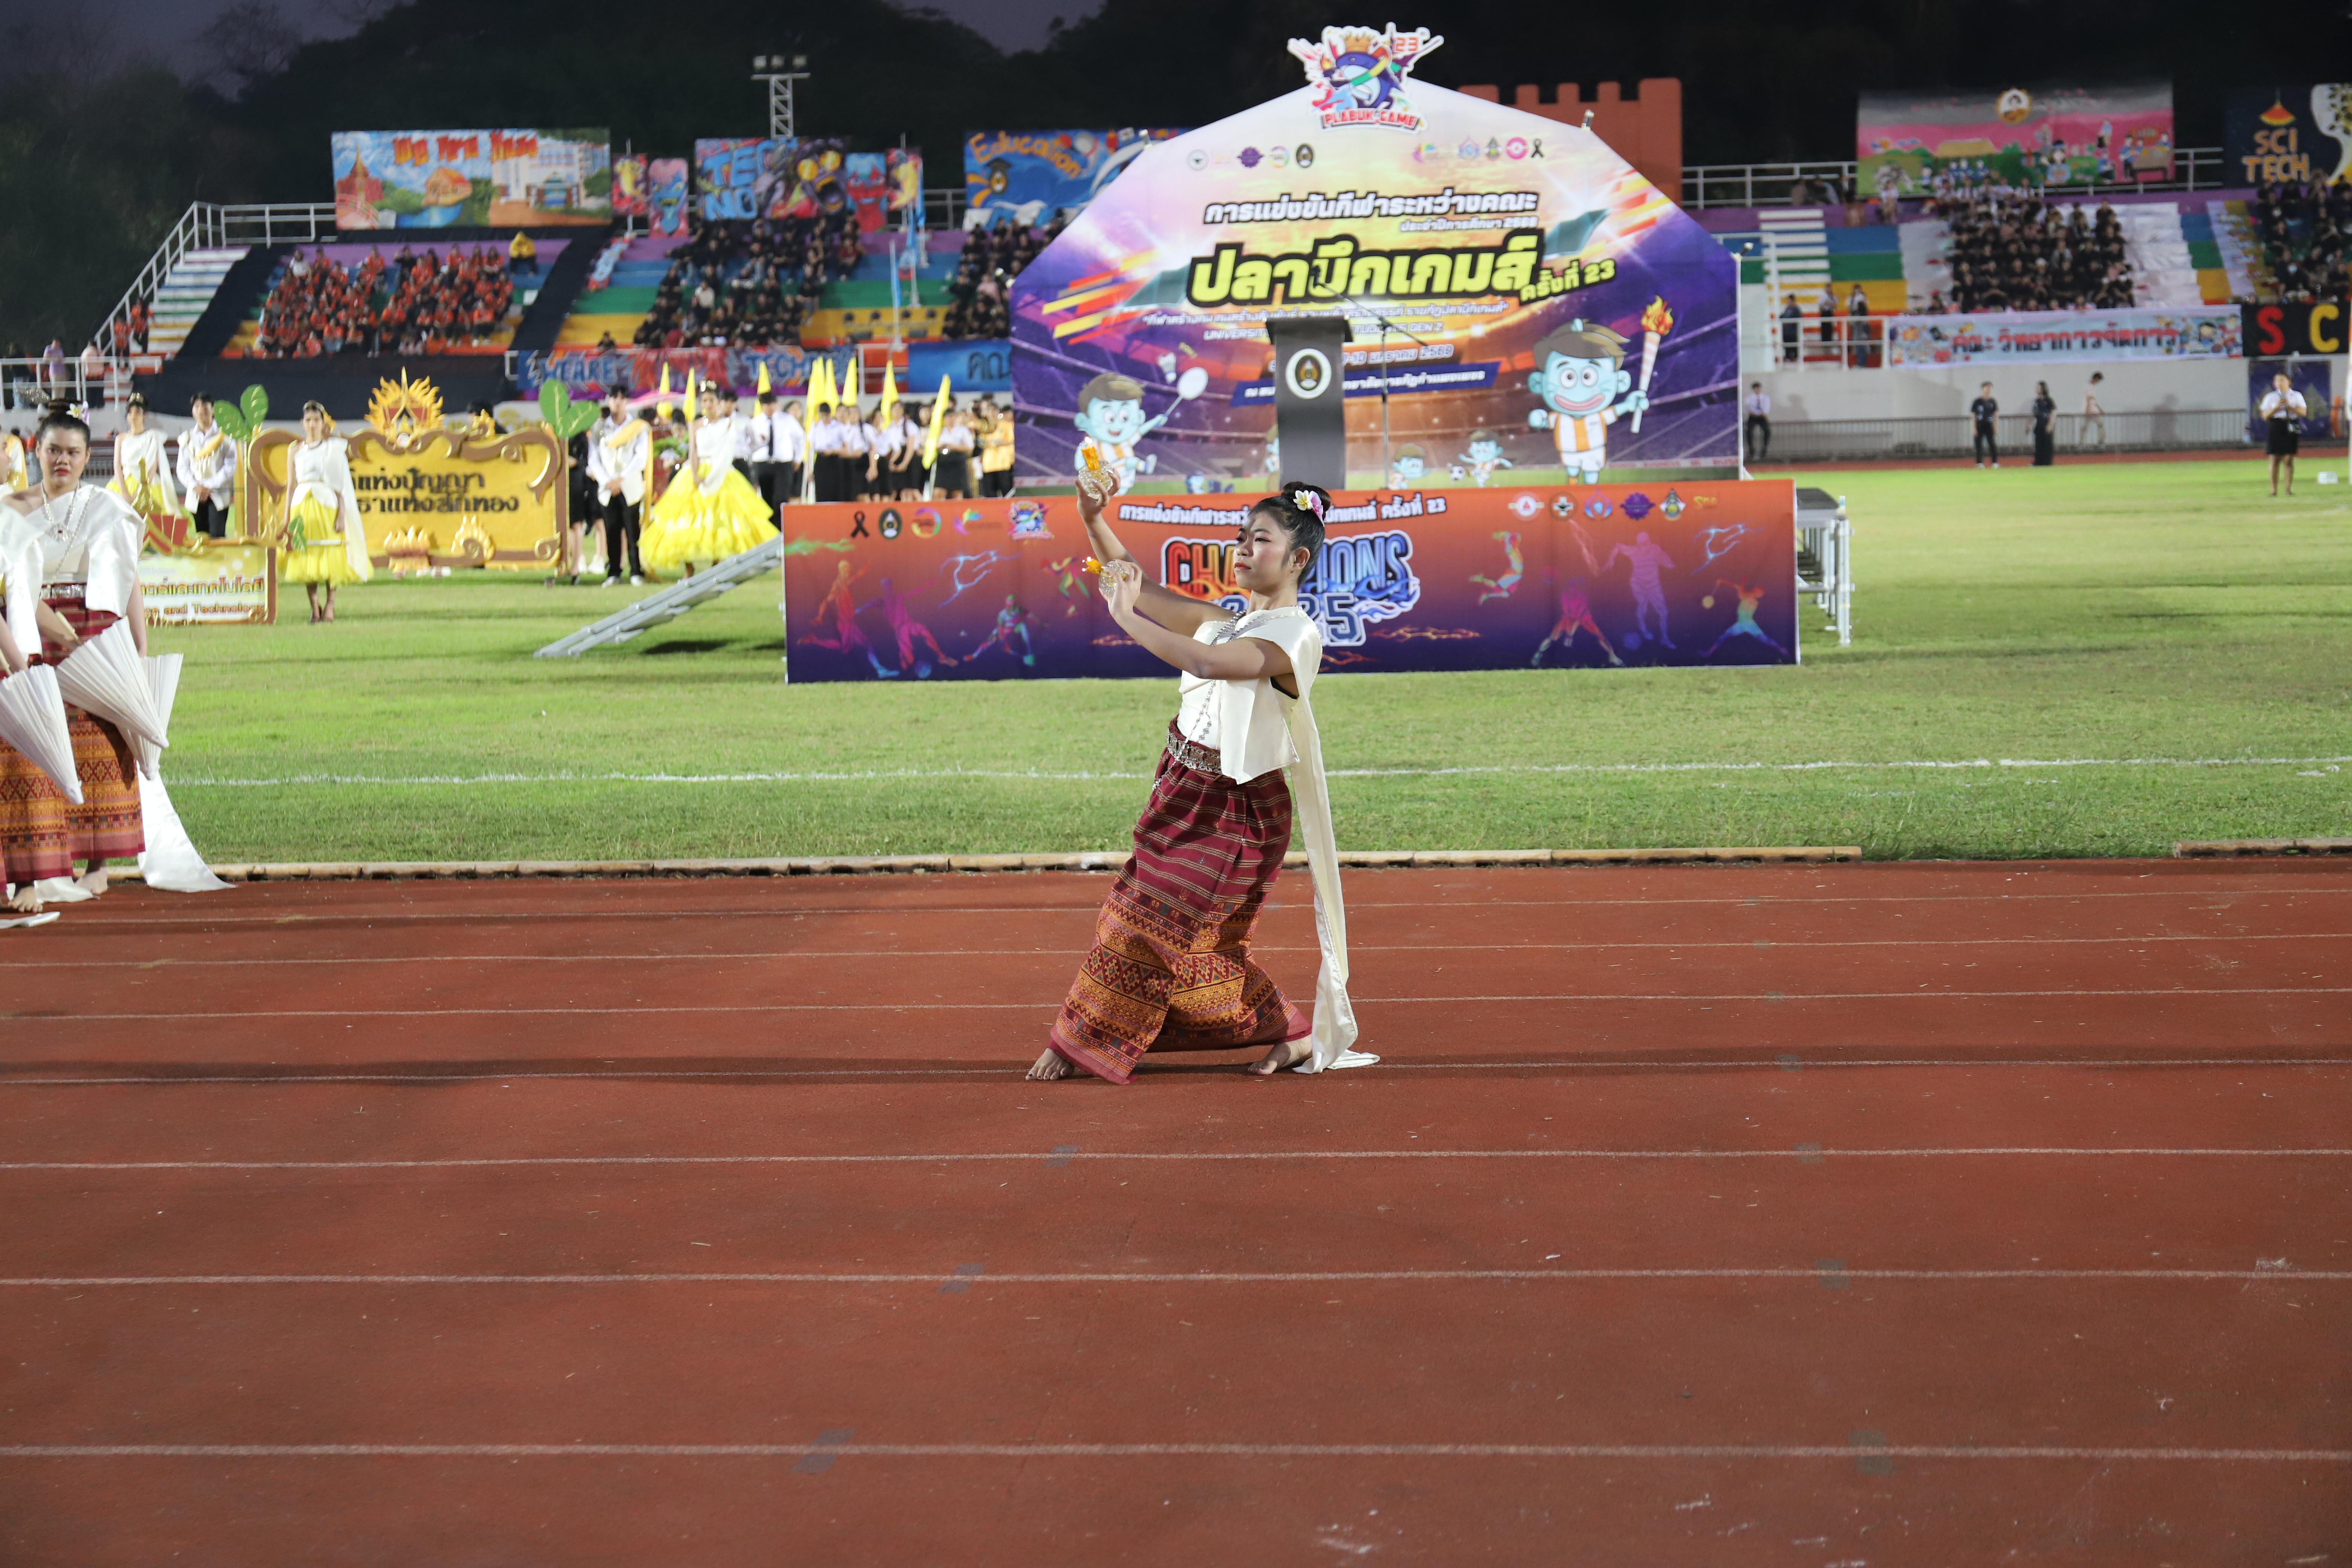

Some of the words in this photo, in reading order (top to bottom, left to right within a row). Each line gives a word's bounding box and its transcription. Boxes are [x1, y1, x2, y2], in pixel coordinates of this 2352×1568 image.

[1395, 37, 1419, 52] 23
[1380, 110, 1418, 127] GAME
[2254, 128, 2298, 155] SCI
[2242, 153, 2310, 183] TECH
[704, 188, 758, 220] NO
[1205, 188, 1538, 223] การแข่งขันกีฬาระหว่างคณะ
[1189, 231, 1541, 304] ปลาบึกเกมส์
[1520, 259, 1580, 302] ครั้งที่
[1584, 258, 1615, 285] 23
[1119, 502, 1250, 525] การแข่งขันกีฬาระหว่
[1380, 492, 1423, 520] ครั้งที่
[1426, 497, 1447, 514] 23
[141, 576, 264, 596] ตร์และเทคโนโลยี
[164, 602, 188, 614] and
